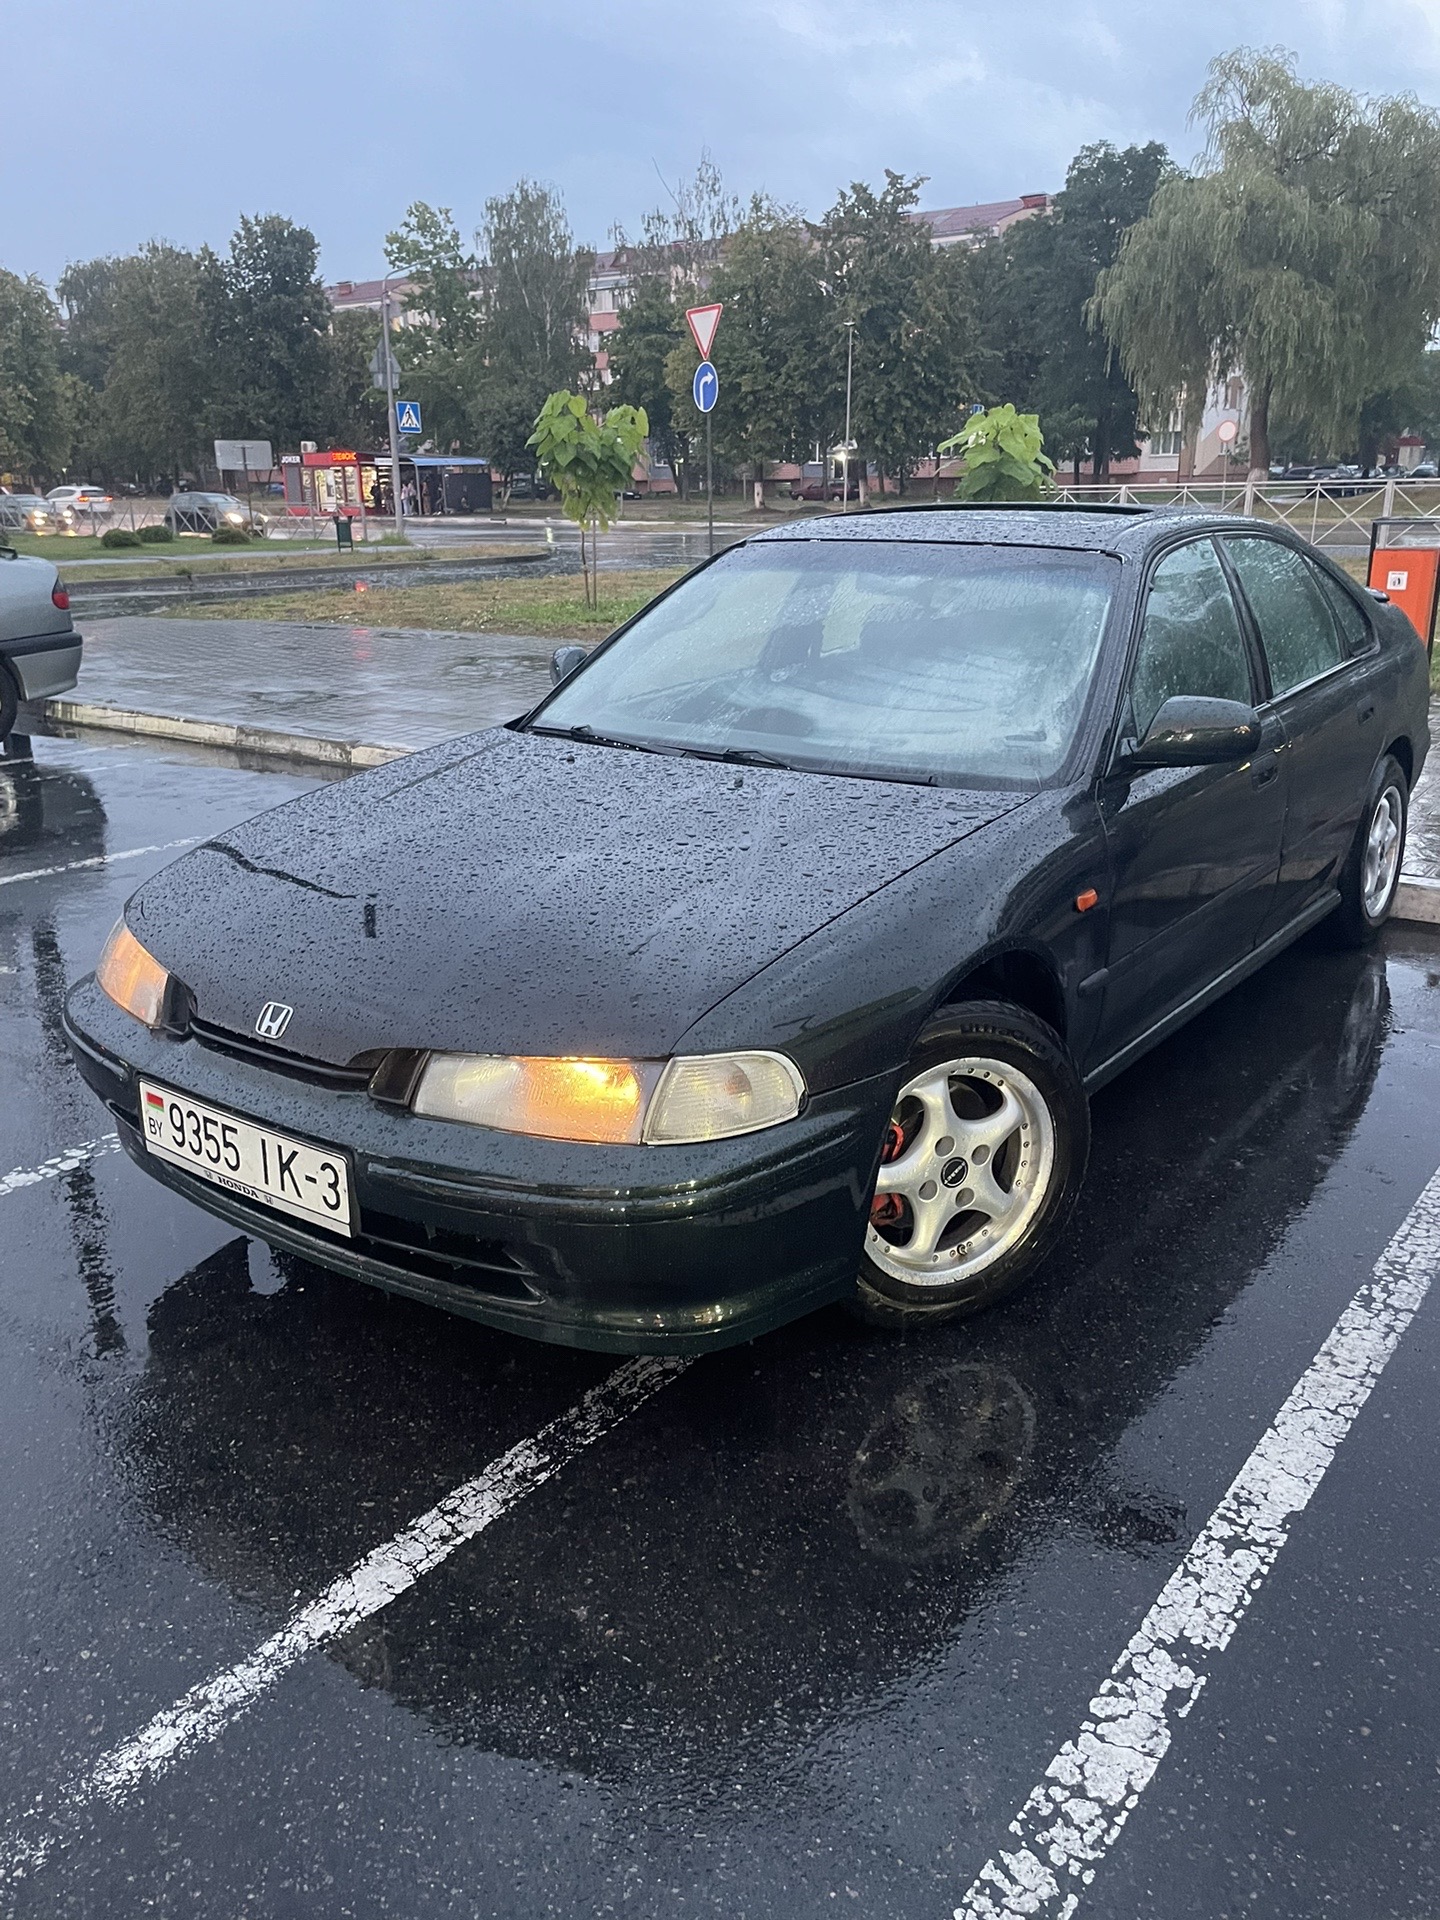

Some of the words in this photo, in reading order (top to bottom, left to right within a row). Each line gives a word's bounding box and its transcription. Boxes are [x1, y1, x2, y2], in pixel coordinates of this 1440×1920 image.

[281, 455, 301, 464] JOKER
[148, 1116, 163, 1138] BY
[169, 1103, 241, 1172] 9355
[261, 1138, 341, 1211] IK-3
[217, 1176, 260, 1199] HONDA
